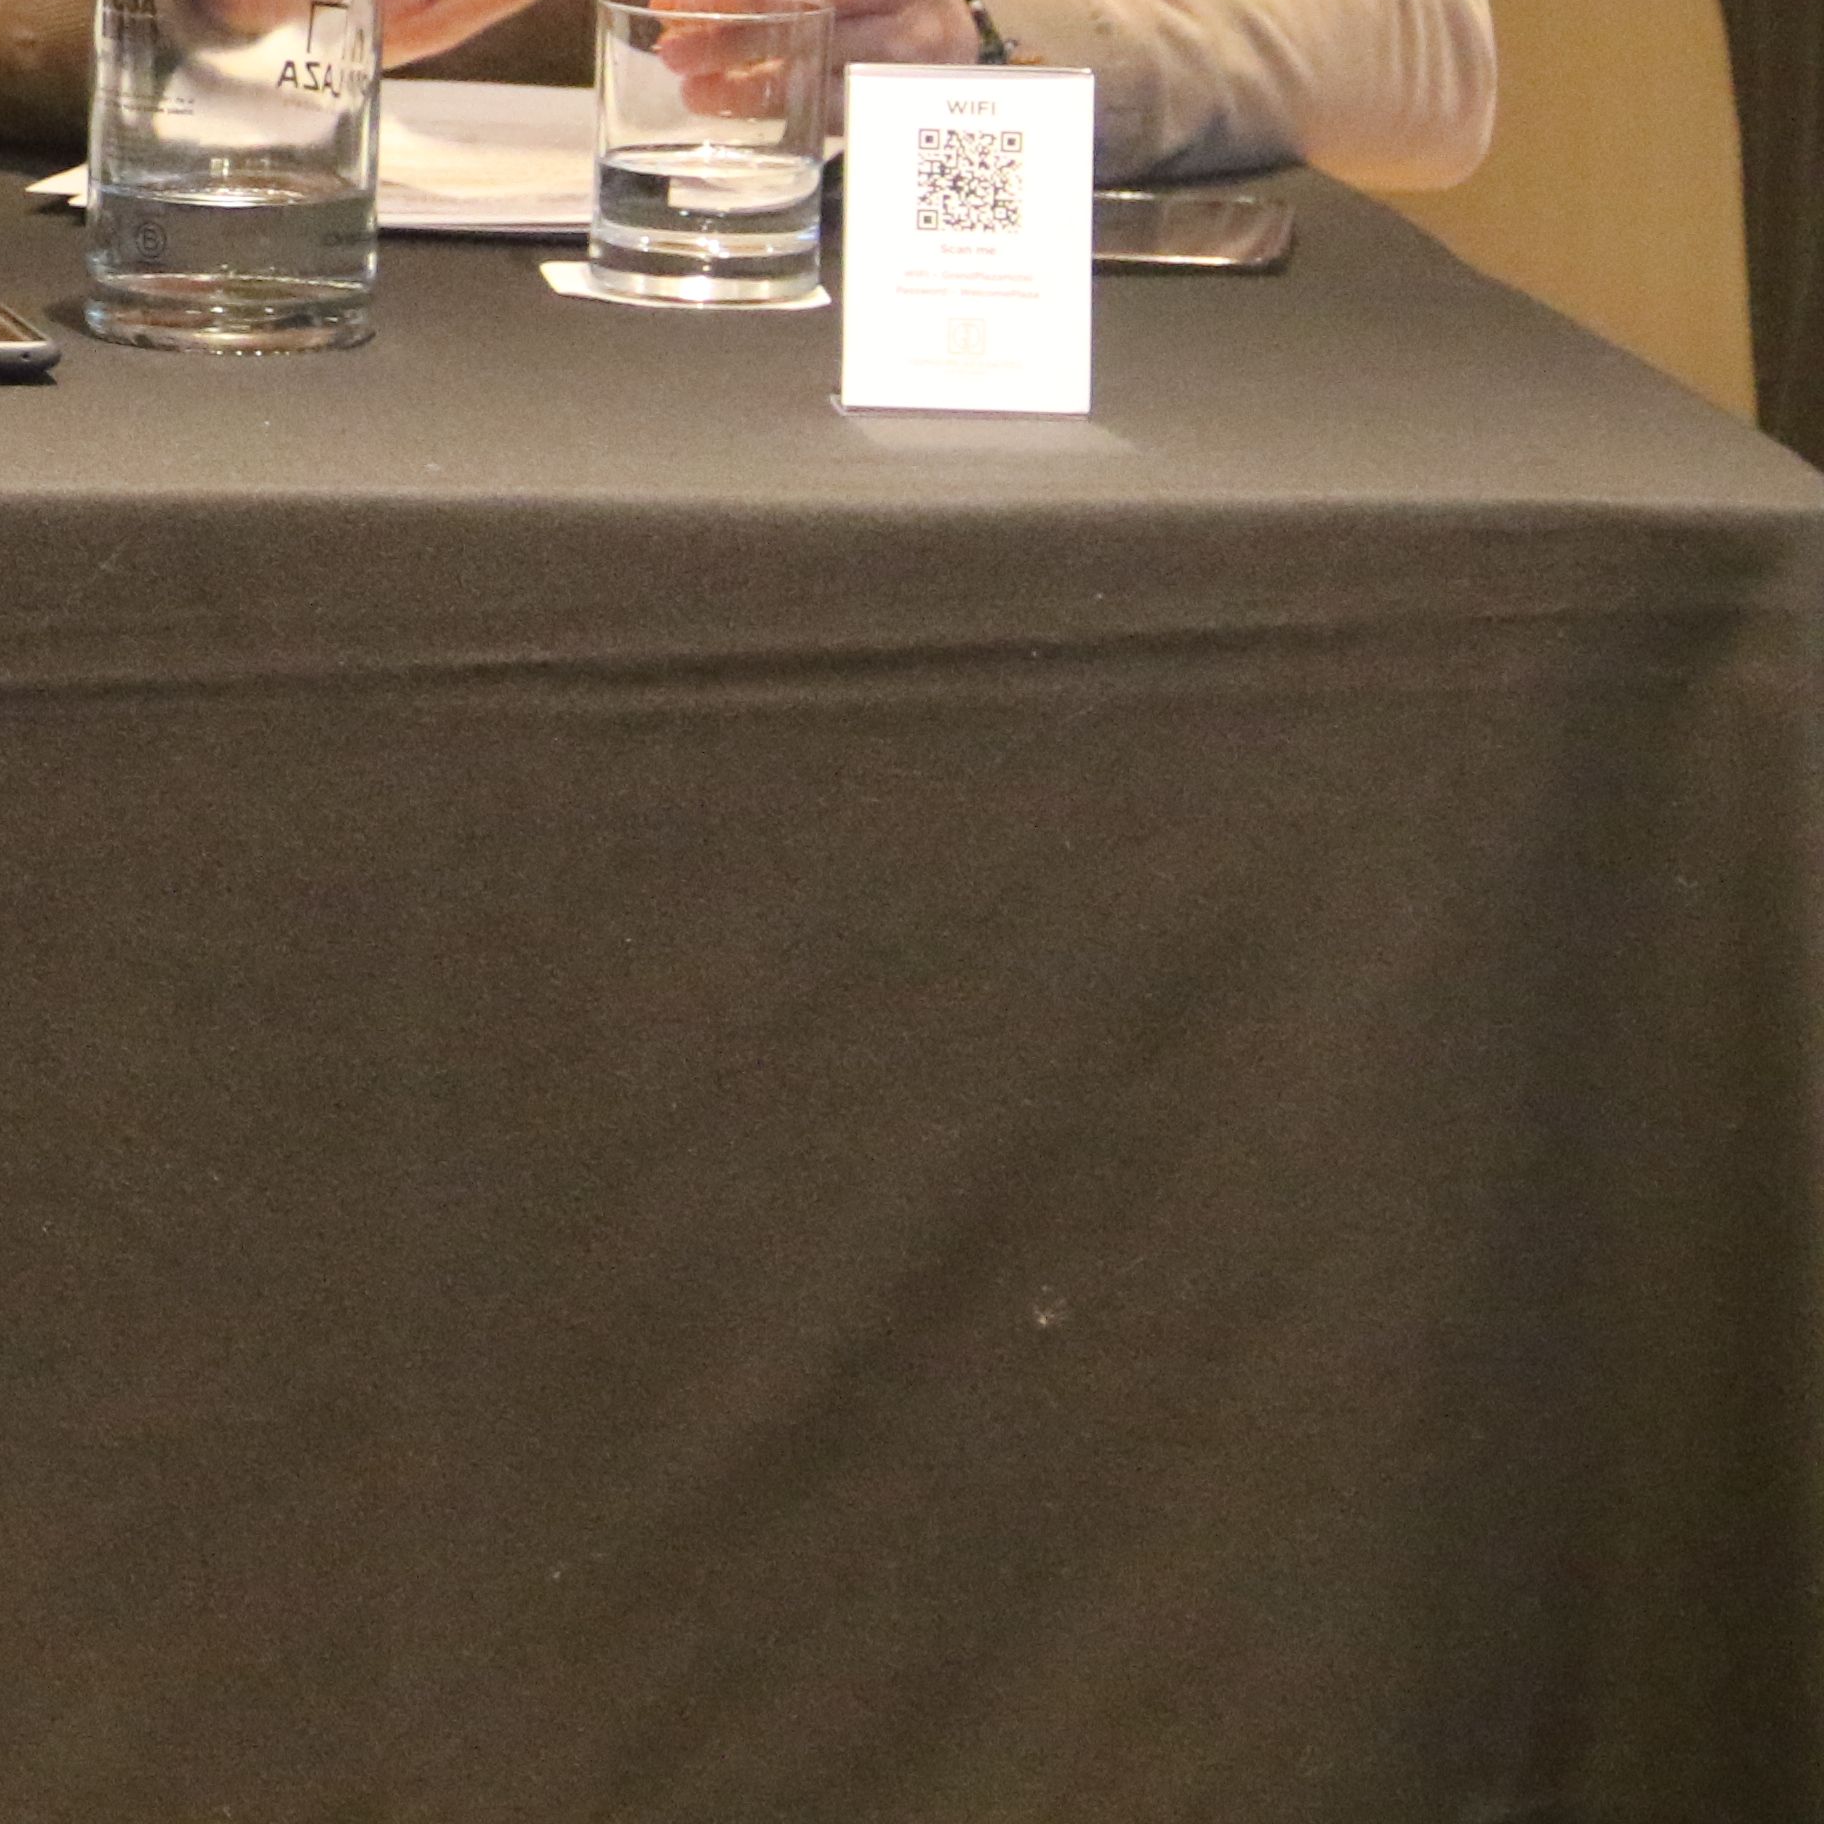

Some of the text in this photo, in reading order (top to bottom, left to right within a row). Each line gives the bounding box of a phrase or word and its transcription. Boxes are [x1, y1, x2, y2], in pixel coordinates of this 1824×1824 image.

[946, 99, 996, 115] WIFI
[940, 244, 997, 255] Scan me
